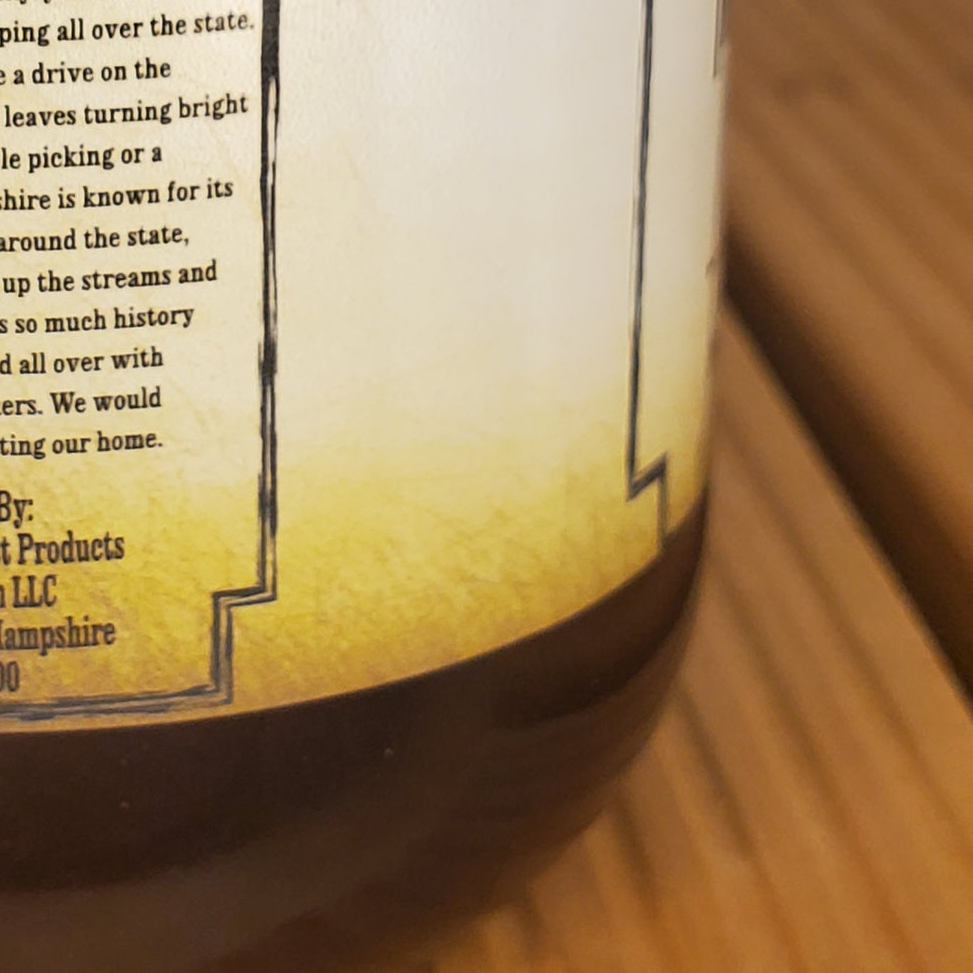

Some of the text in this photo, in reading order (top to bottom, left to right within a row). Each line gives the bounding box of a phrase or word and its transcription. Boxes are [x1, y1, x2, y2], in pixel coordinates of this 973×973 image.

[57, 17, 84, 42] all
[92, 22, 144, 40] over
[150, 13, 187, 37] the
[193, 11, 254, 34] state.
[32, 61, 94, 84] drive
[4, 105, 77, 128] leaves
[84, 99, 172, 125] turning
[178, 93, 248, 121] bright
[28, 144, 115, 174] picking
[83, 186, 160, 208] known
[167, 180, 201, 202] for
[83, 226, 120, 249] the
[127, 225, 189, 246] state,
[37, 269, 75, 293] the
[81, 269, 172, 291] streams
[178, 258, 218, 284] and
[44, 308, 107, 333] much
[113, 307, 195, 329] history
[19, 352, 47, 374] all
[53, 356, 105, 374] over
[110, 346, 164, 370] with
[49, 391, 87, 414] We
[93, 385, 162, 412] would
[52, 438, 92, 454] our
[96, 430, 163, 452] home.
[17, 529, 125, 565] Products
[11, 574, 57, 608] LLC
